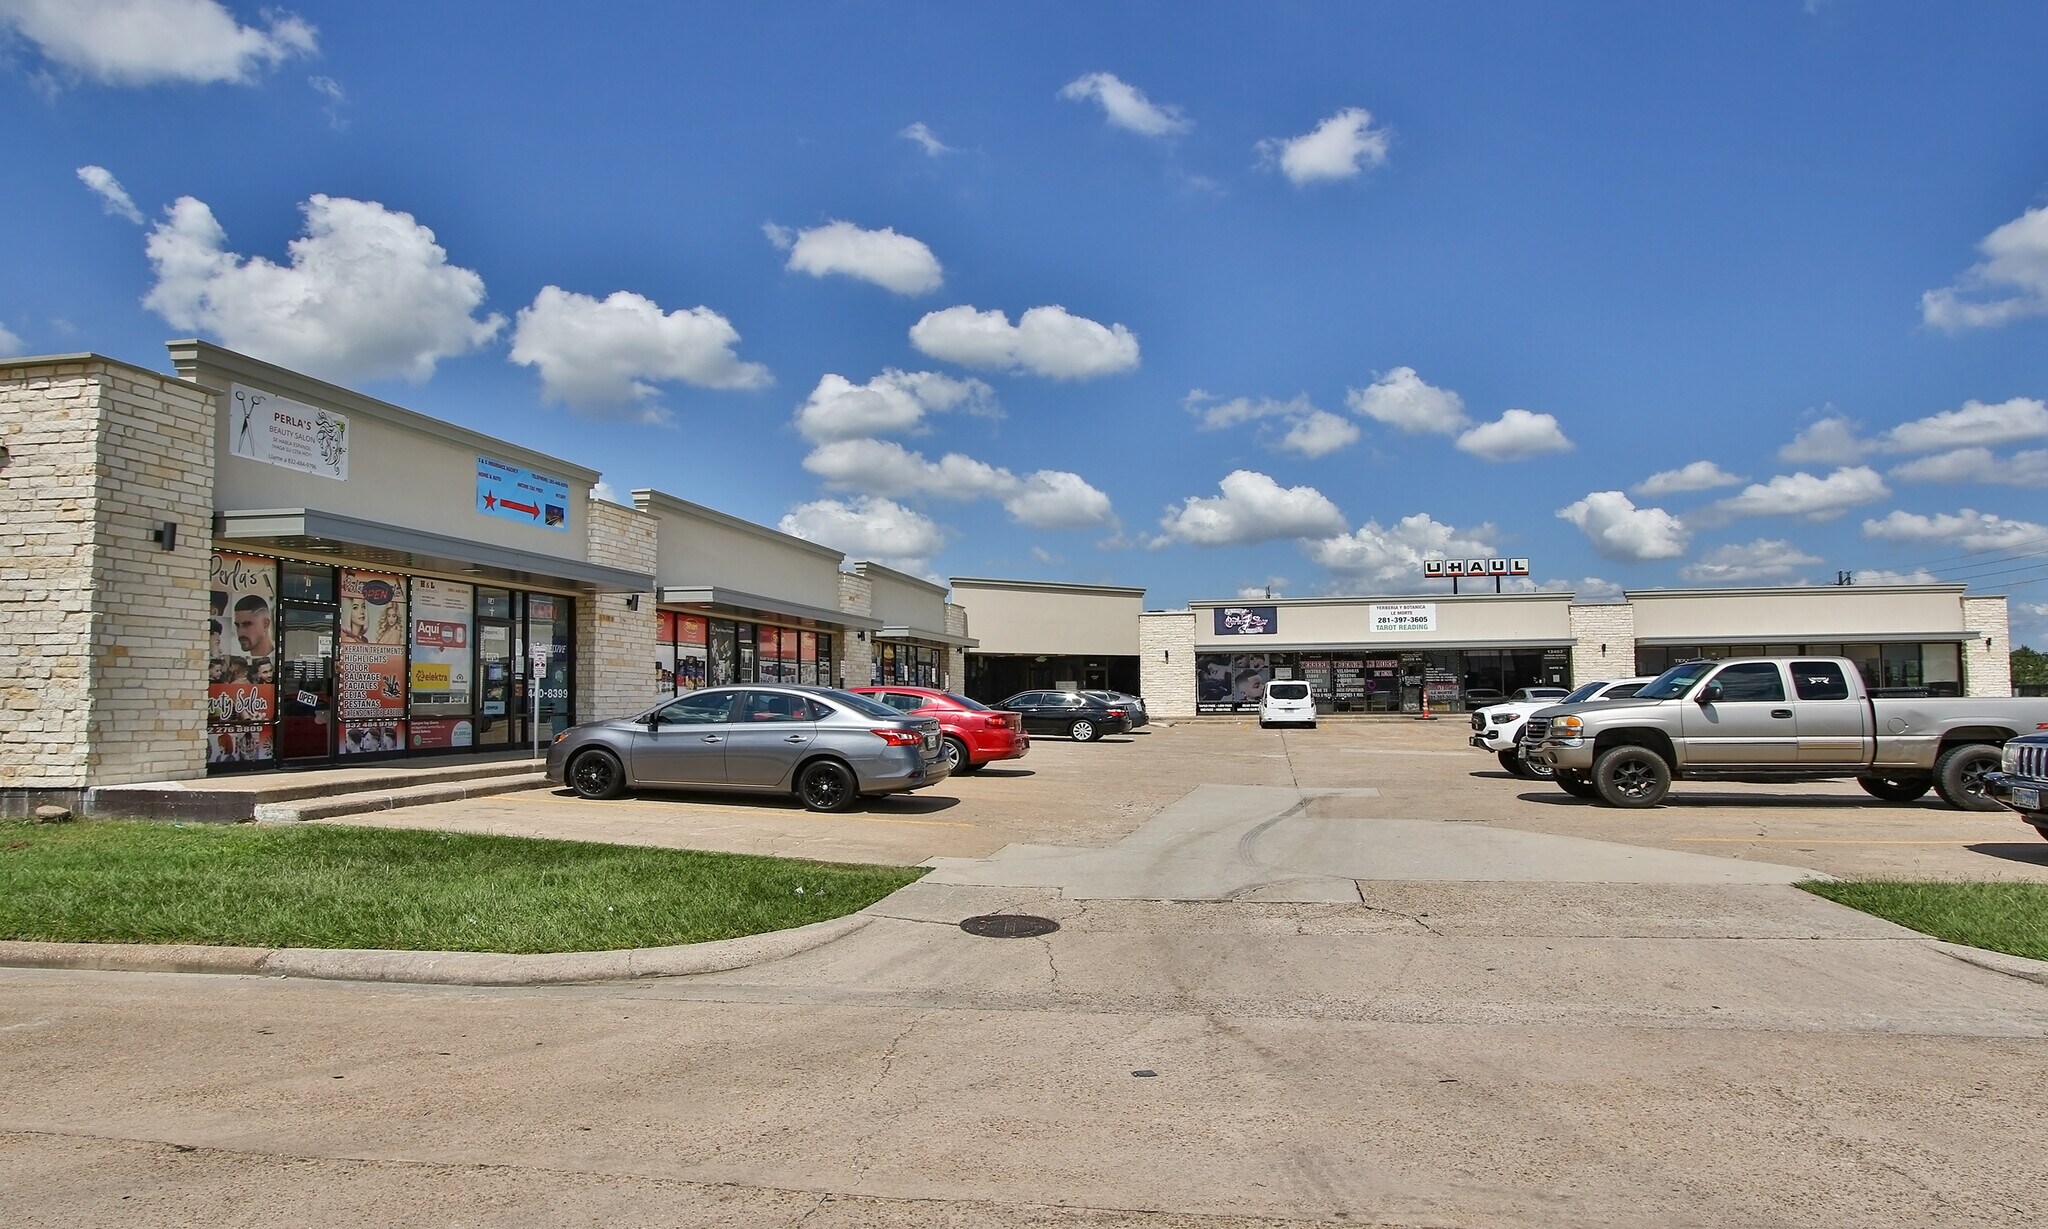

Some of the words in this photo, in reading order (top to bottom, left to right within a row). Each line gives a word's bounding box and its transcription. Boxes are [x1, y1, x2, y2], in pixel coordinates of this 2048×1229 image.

[274, 412, 312, 430] PERLA'S
[269, 426, 294, 438] BEAUTY
[294, 433, 316, 444] SALON
[210, 555, 257, 591] Perla's
[363, 589, 388, 600] OPEN
[418, 622, 440, 636] Aquí
[344, 645, 369, 654] KERATIN
[370, 646, 404, 655] TREATMENTS
[344, 655, 387, 663] HIGHLIGHTS
[425, 672, 447, 681] elektra
[300, 692, 317, 705] OPEN
[528, 688, 568, 699] 40-8399
[235, 686, 268, 715] Salon
[344, 709, 377, 717] EXTENSIONES
